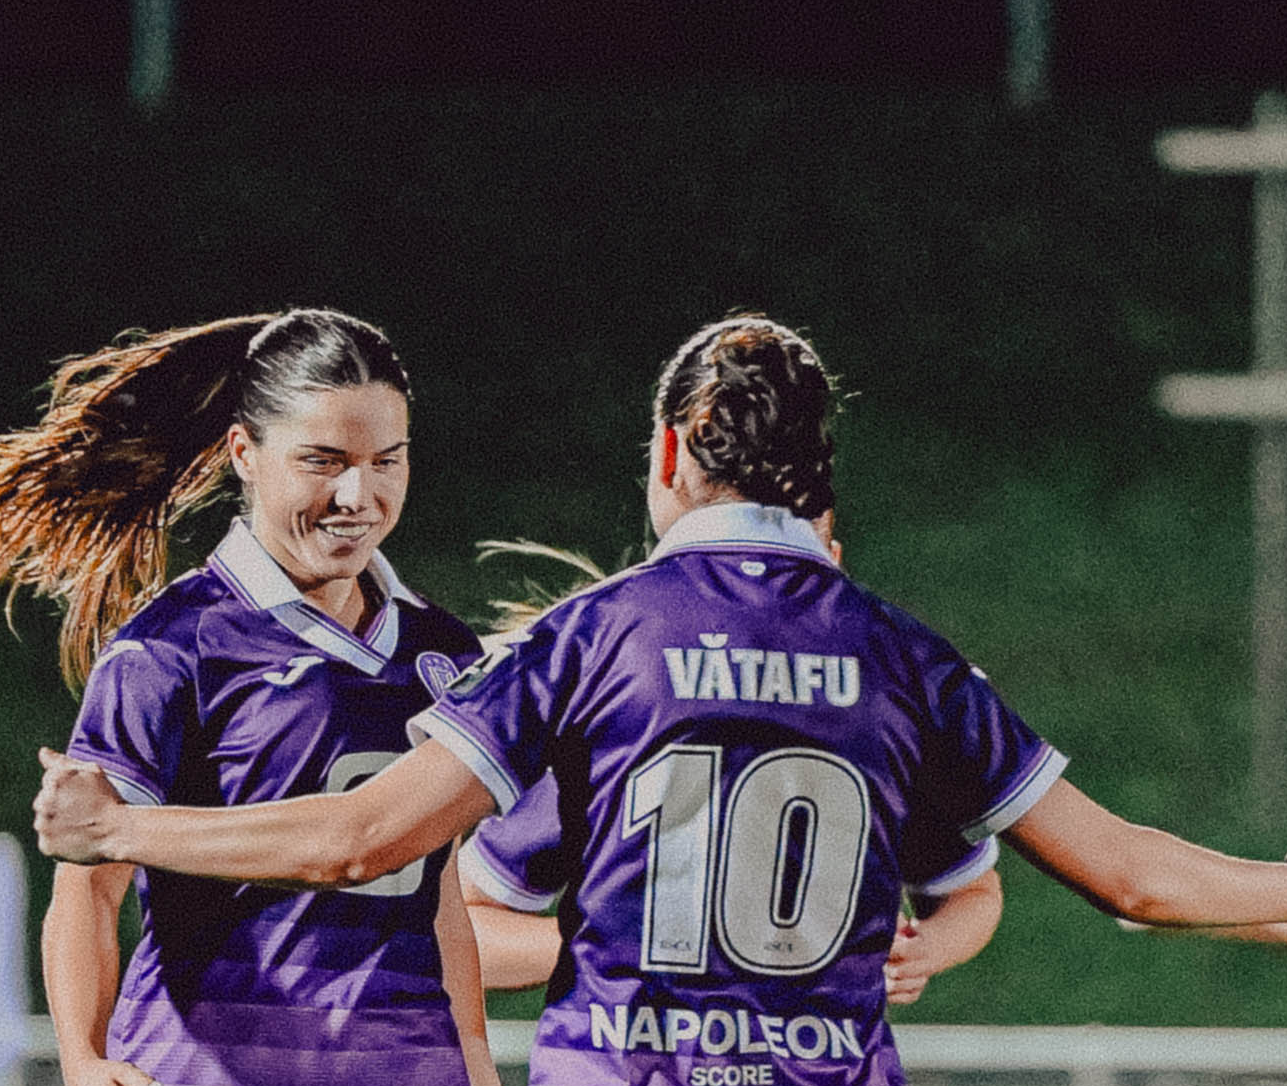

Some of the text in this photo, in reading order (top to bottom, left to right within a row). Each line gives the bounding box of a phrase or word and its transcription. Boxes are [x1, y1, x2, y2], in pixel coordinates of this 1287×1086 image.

[663, 633, 861, 708] VĂTAFU
[622, 743, 872, 977] 10
[588, 1003, 866, 1061] NAPOLEON
